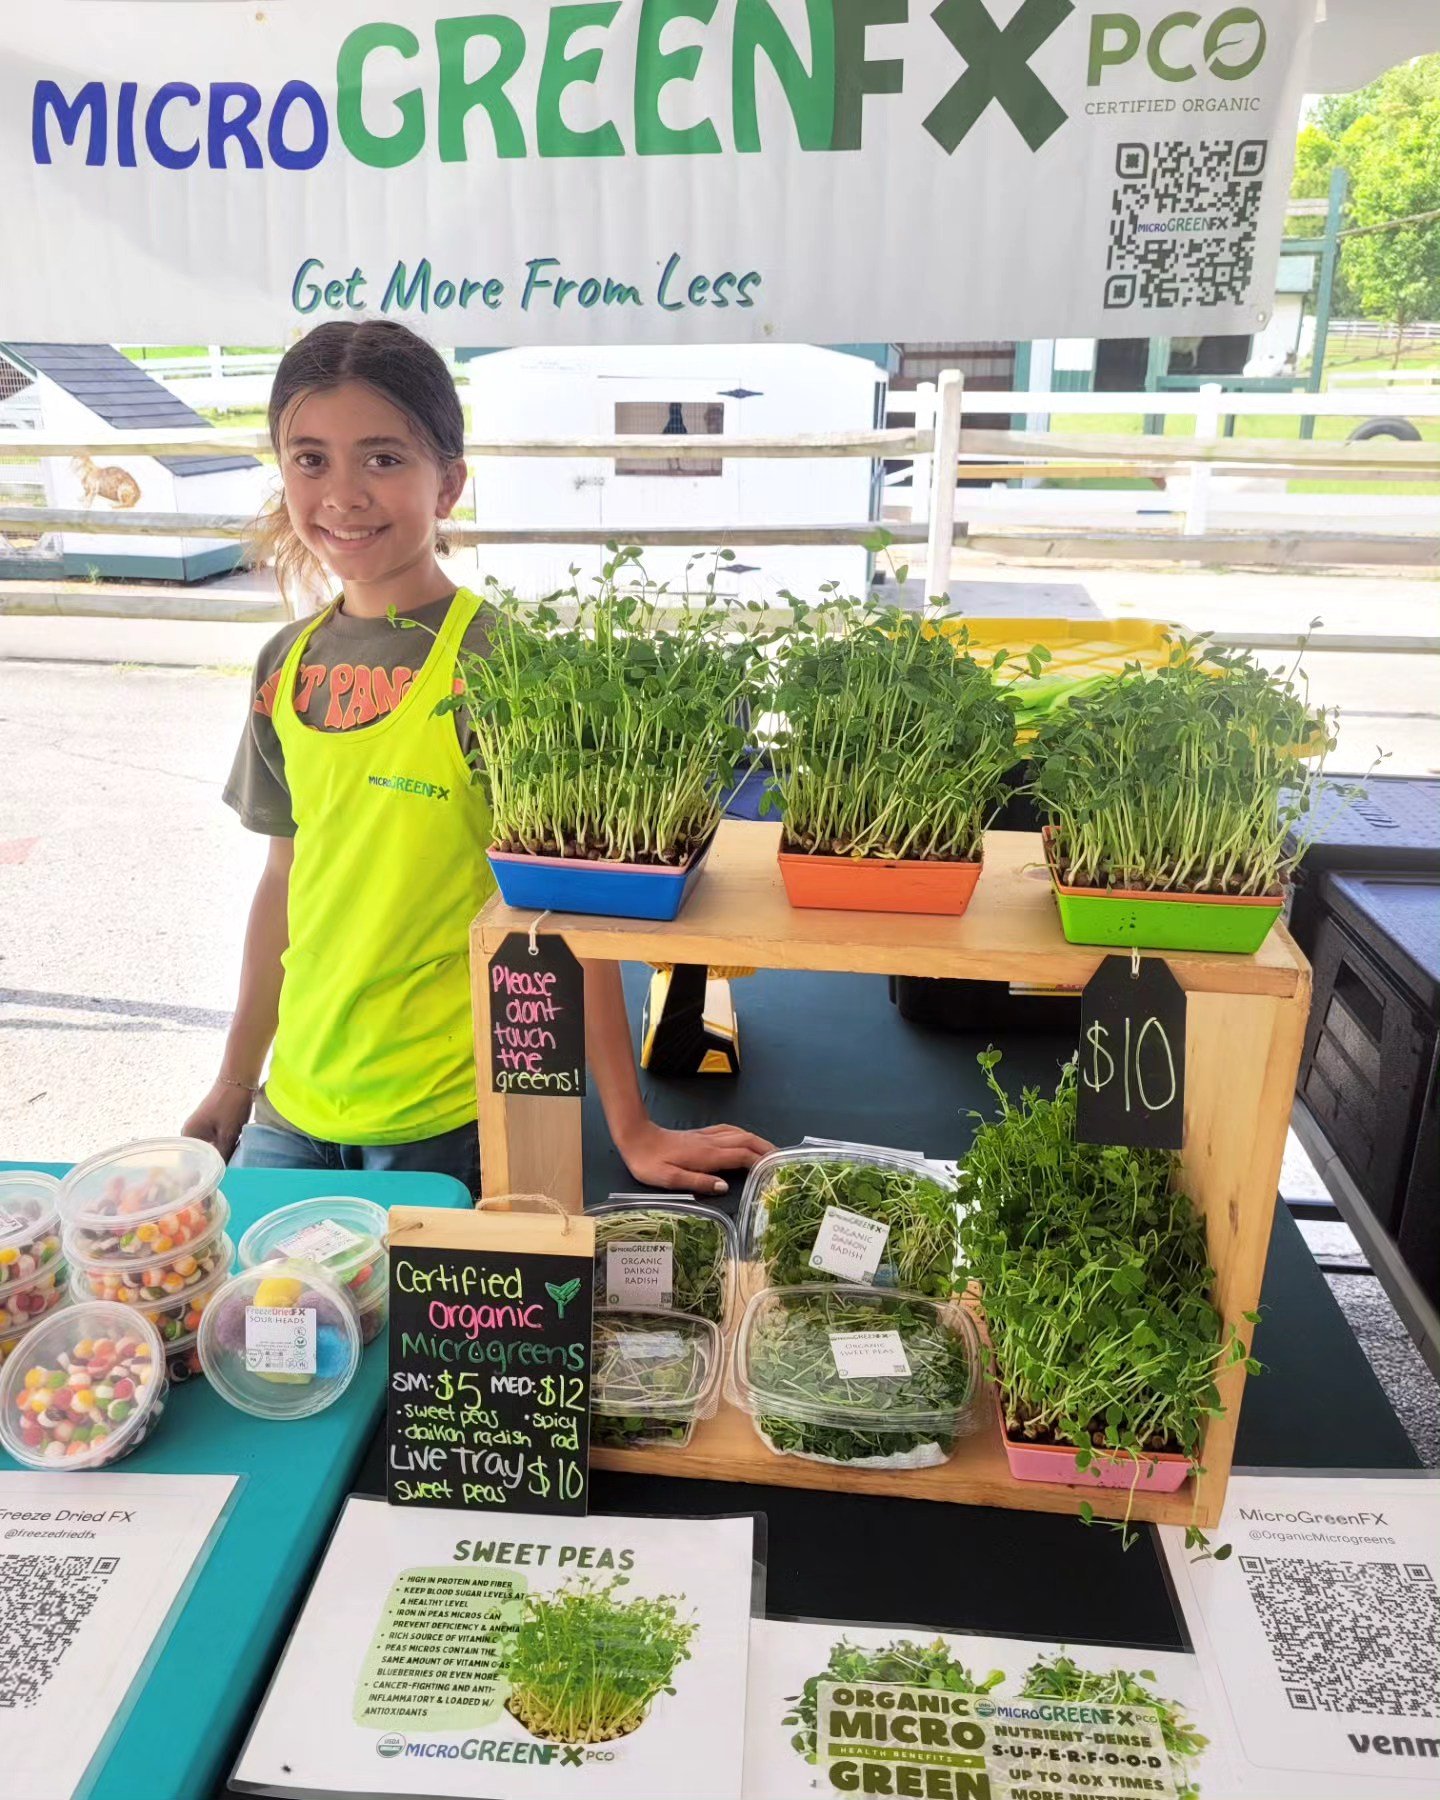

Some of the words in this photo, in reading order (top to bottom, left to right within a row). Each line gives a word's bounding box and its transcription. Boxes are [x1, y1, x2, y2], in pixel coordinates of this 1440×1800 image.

[1087, 7, 1267, 86] PCO
[1085, 99, 1176, 115] CERTIFIED
[1182, 97, 1260, 113] ORGANIC
[292, 258, 367, 314] Get
[380, 258, 504, 314] More
[520, 258, 645, 311] From
[656, 252, 762, 312] Less
[492, 965, 556, 996] Please
[494, 1021, 556, 1049] touch
[497, 1048, 543, 1073] the
[1083, 1016, 1176, 1112] $10
[496, 1068, 580, 1093] greens!
[621, 1257, 662, 1265] ORGANIC
[396, 1260, 523, 1299] Certified
[625, 1277, 658, 1285] RADISH
[401, 1331, 586, 1375] Microgreens
[434, 1369, 482, 1409] $5
[537, 1375, 586, 1412] $12
[403, 1403, 456, 1422] sweet
[460, 1408, 499, 1428] peas
[532, 1412, 577, 1430] spicy
[473, 1429, 532, 1448] radish
[550, 1428, 580, 1450] rad
[390, 1444, 448, 1471] Live
[451, 1446, 524, 1489] Tray
[527, 1455, 584, 1500] $10
[462, 1482, 507, 1504] peas
[55, 1510, 106, 1522] Dried
[108, 1511, 137, 1523] FX
[1239, 1508, 1389, 1527] MicroGreenFX
[4, 1528, 97, 1539] @freezedriedfx
[1249, 1529, 1396, 1546] @OrganicMicrogreens
[453, 1540, 552, 1566] SWEET
[558, 1546, 635, 1571] PEAS
[407, 1576, 426, 1584] HIGH
[437, 1577, 470, 1586] PROTEIN
[472, 1579, 489, 1587] AND
[490, 1580, 512, 1588] FIBER
[407, 1599, 443, 1607] HEALTHY
[444, 1600, 469, 1608] LEVEL
[427, 1588, 454, 1596] BLOOD
[455, 1589, 482, 1598] SUGAR
[483, 1591, 513, 1599] LEVELS
[514, 1592, 526, 1600] AT
[417, 1609, 427, 1617] IN
[428, 1610, 449, 1618] PEAS
[450, 1611, 482, 1620] MICROS
[484, 1612, 501, 1620] CAN
[393, 1620, 430, 1629] PREVENT
[431, 1622, 479, 1631] DEFICIENCY
[489, 1625, 521, 1633] ANEMIA
[389, 1632, 409, 1640] RICH
[410, 1633, 443, 1641] SOURCE
[445, 1634, 456, 1642] OF
[458, 1635, 490, 1643] VITAMIN
[409, 1645, 440, 1653] MICROS
[442, 1646, 480, 1655] CONTAIN
[481, 1648, 497, 1656] THE
[381, 1656, 404, 1664] SAME
[406, 1657, 441, 1666] AMOUNT
[443, 1658, 454, 1666] OF
[456, 1659, 490, 1668] VITAMIN
[499, 1661, 510, 1669] AS
[377, 1668, 434, 1678] BLUEBERRIES
[435, 1670, 448, 1678] OR
[450, 1671, 473, 1679] EVEN
[373, 1681, 450, 1691] CANCER-FIGHTING
[452, 1683, 470, 1692] AND
[472, 1685, 496, 1694] ANTI-
[368, 1694, 434, 1704] INFLAMMATORY
[436, 1696, 443, 1704] &
[446, 1696, 480, 1706] LOADED
[481, 1699, 495, 1707] W/
[832, 1688, 970, 1717] ORGANIC
[364, 1707, 428, 1717] ANTIOXIDANTS
[1135, 1714, 1158, 1724] PCO
[830, 1710, 986, 1750] MICRO
[994, 1725, 1152, 1748] NUTRIENT-DENSE
[405, 1738, 586, 1768] MICROGREENFX
[586, 1751, 615, 1762] PCO
[841, 1746, 886, 1757] HEALTH
[894, 1750, 953, 1763] BENEFITS
[829, 1760, 992, 1800] GREEN
[1009, 1769, 1033, 1781] UP
[1037, 1771, 1062, 1783] TO
[1067, 1773, 1104, 1787] 40X
[1108, 1776, 1165, 1791] TIMES
